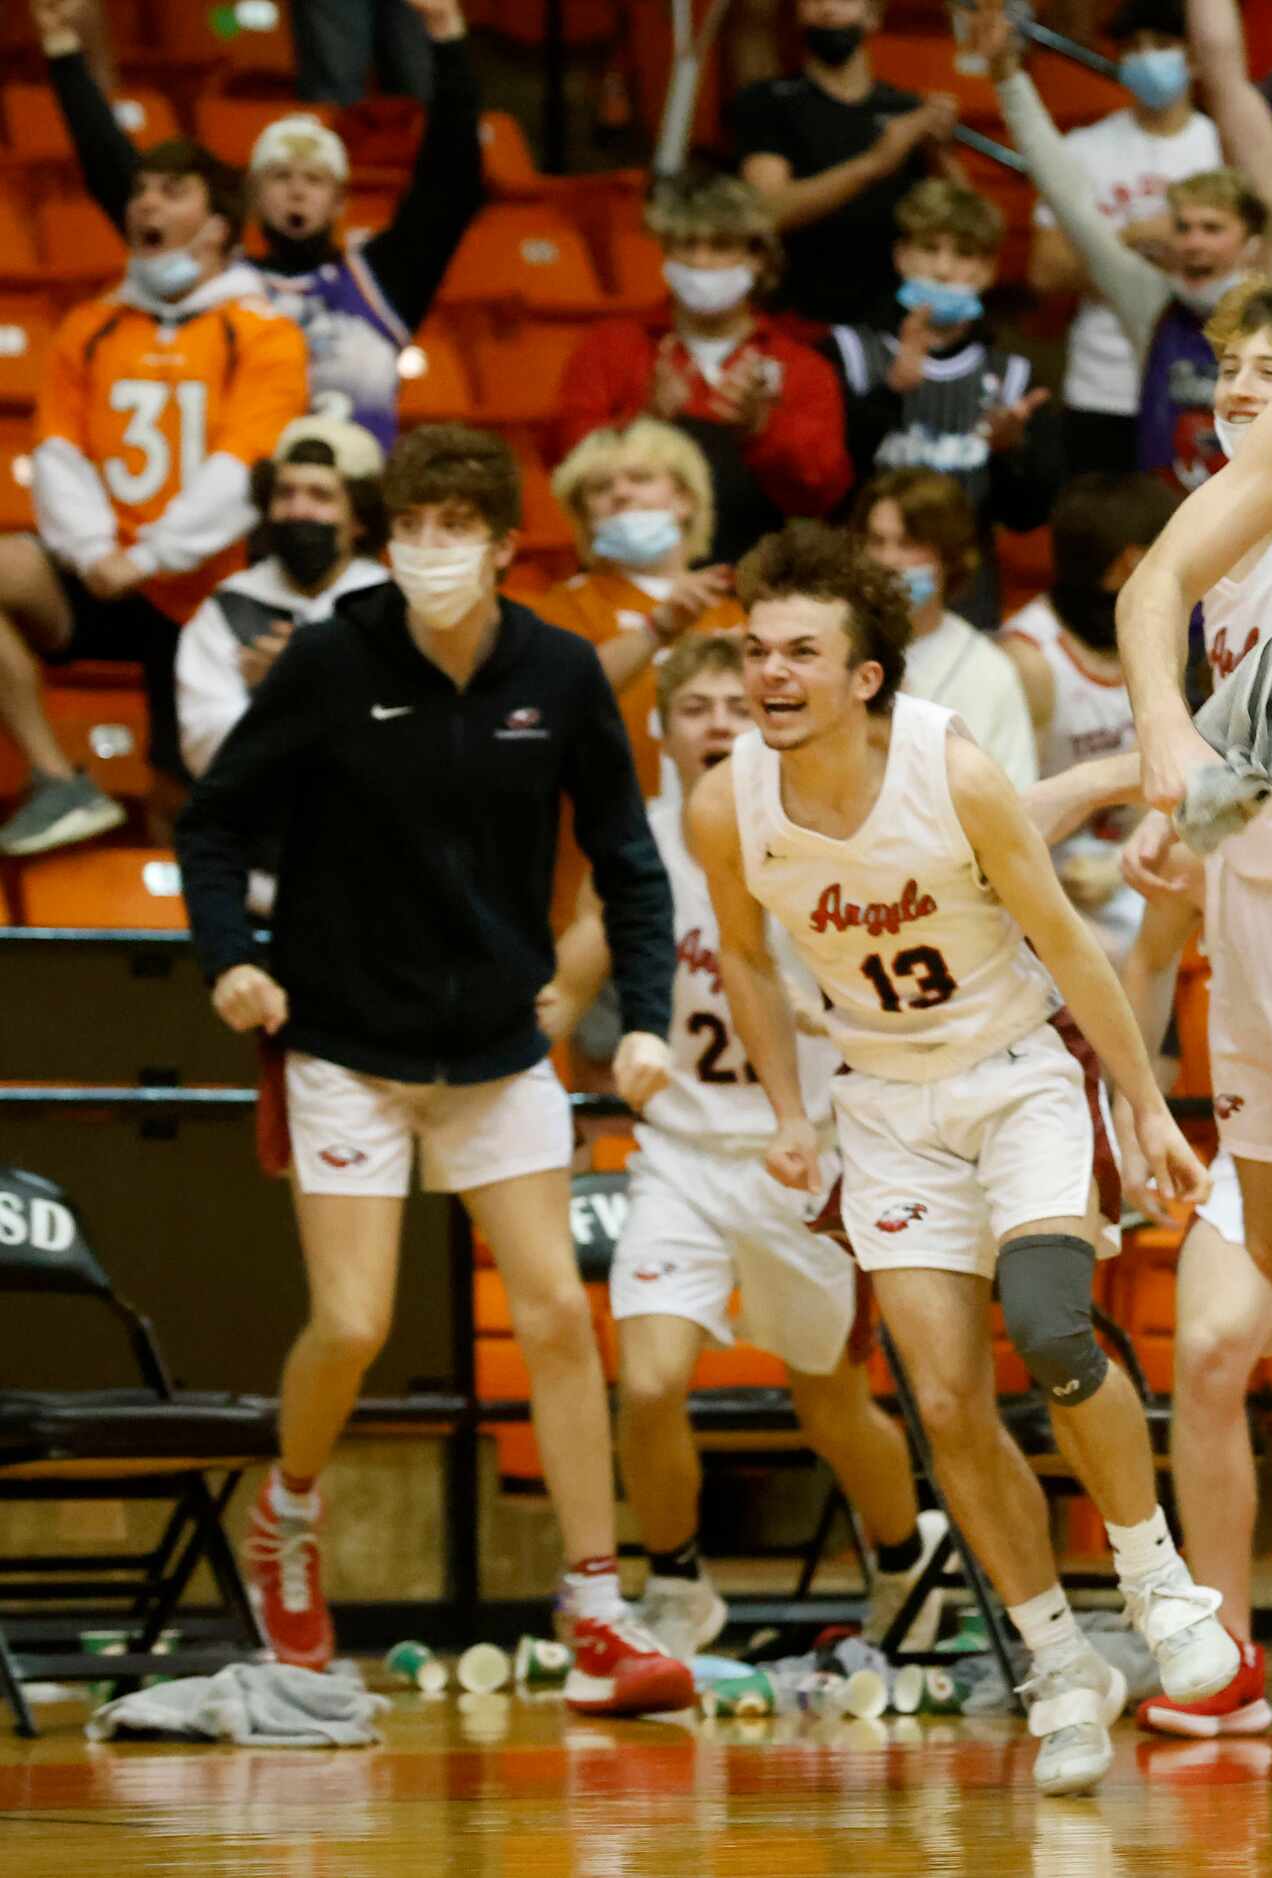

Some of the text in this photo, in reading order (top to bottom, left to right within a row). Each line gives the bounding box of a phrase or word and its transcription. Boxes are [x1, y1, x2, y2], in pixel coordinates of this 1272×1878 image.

[105, 378, 208, 506] 31
[809, 878, 937, 937] Argyle
[859, 944, 959, 1013] 13
[686, 1010, 759, 1084] 2
